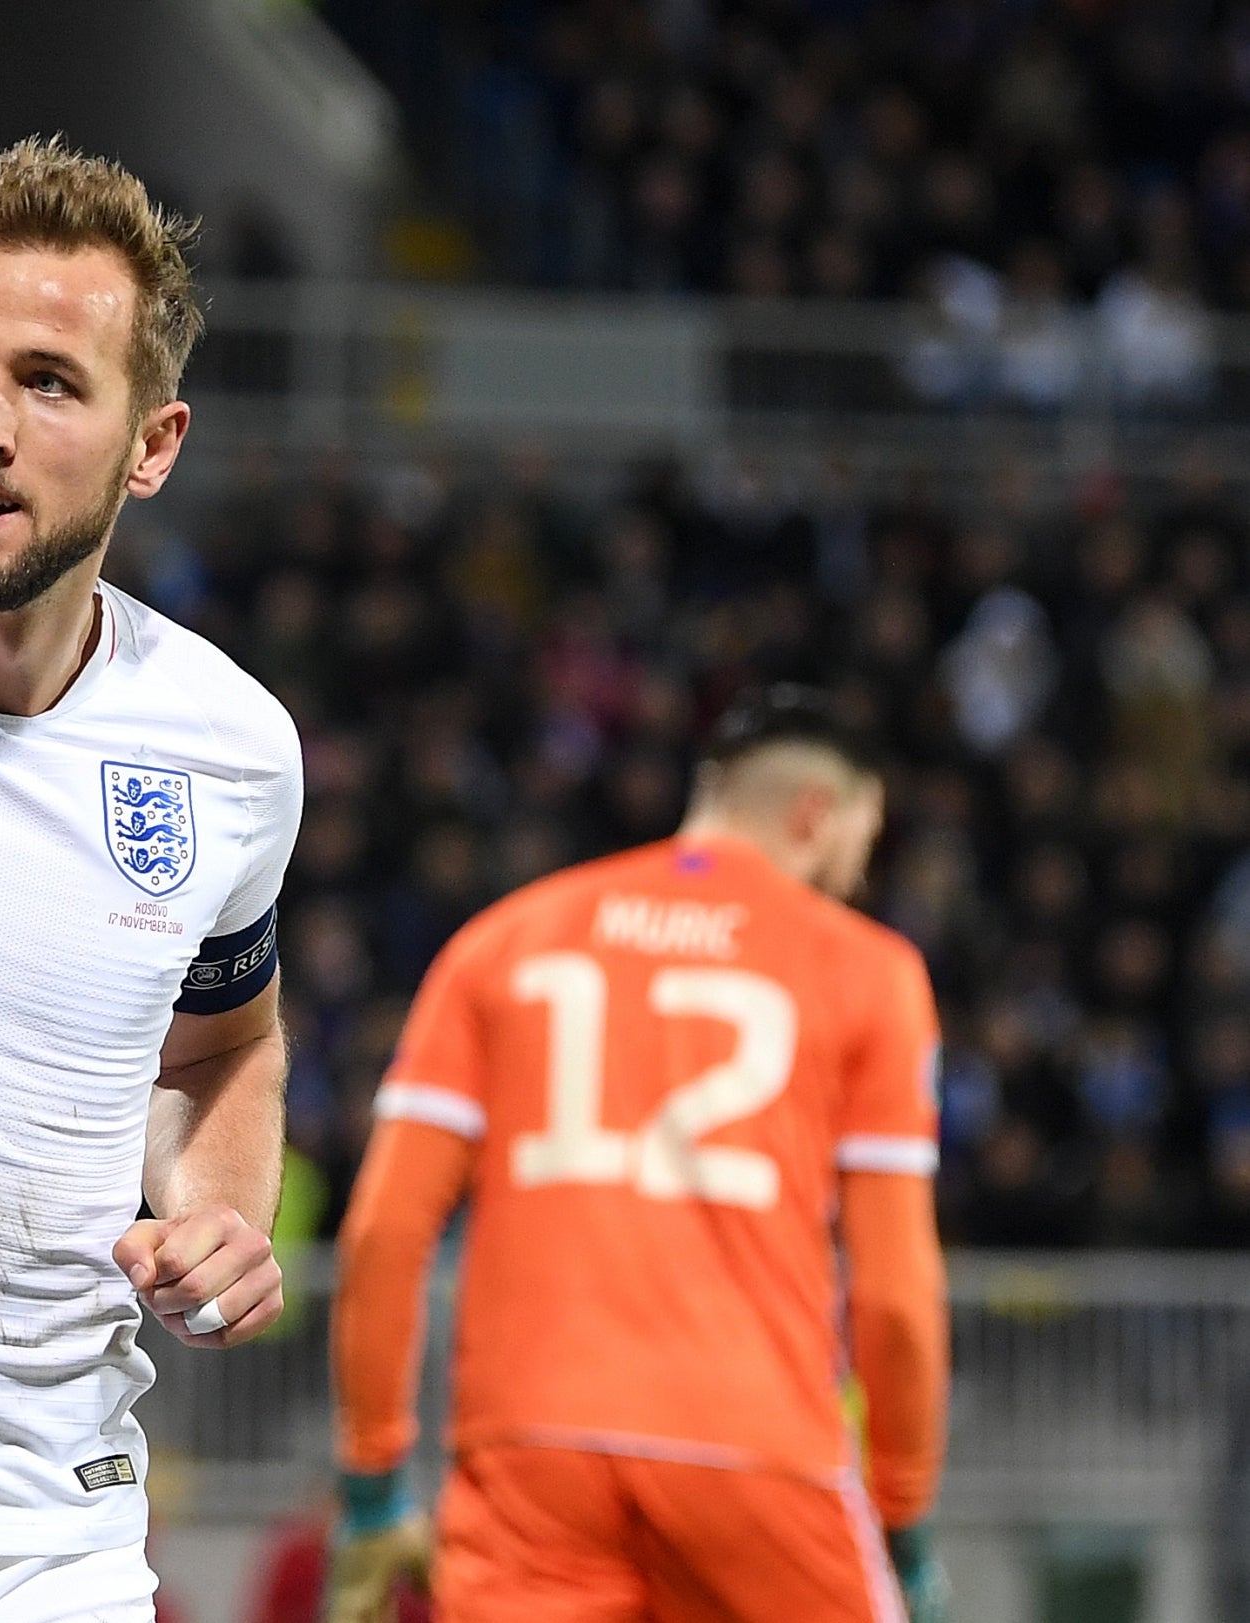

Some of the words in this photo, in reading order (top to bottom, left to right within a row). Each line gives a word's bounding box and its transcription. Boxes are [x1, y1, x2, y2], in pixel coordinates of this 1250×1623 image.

[135, 902, 168, 917] KOSOVO
[108, 912, 119, 925] 17
[119, 915, 167, 933] NOVEMBER
[511, 952, 797, 1209] 12
